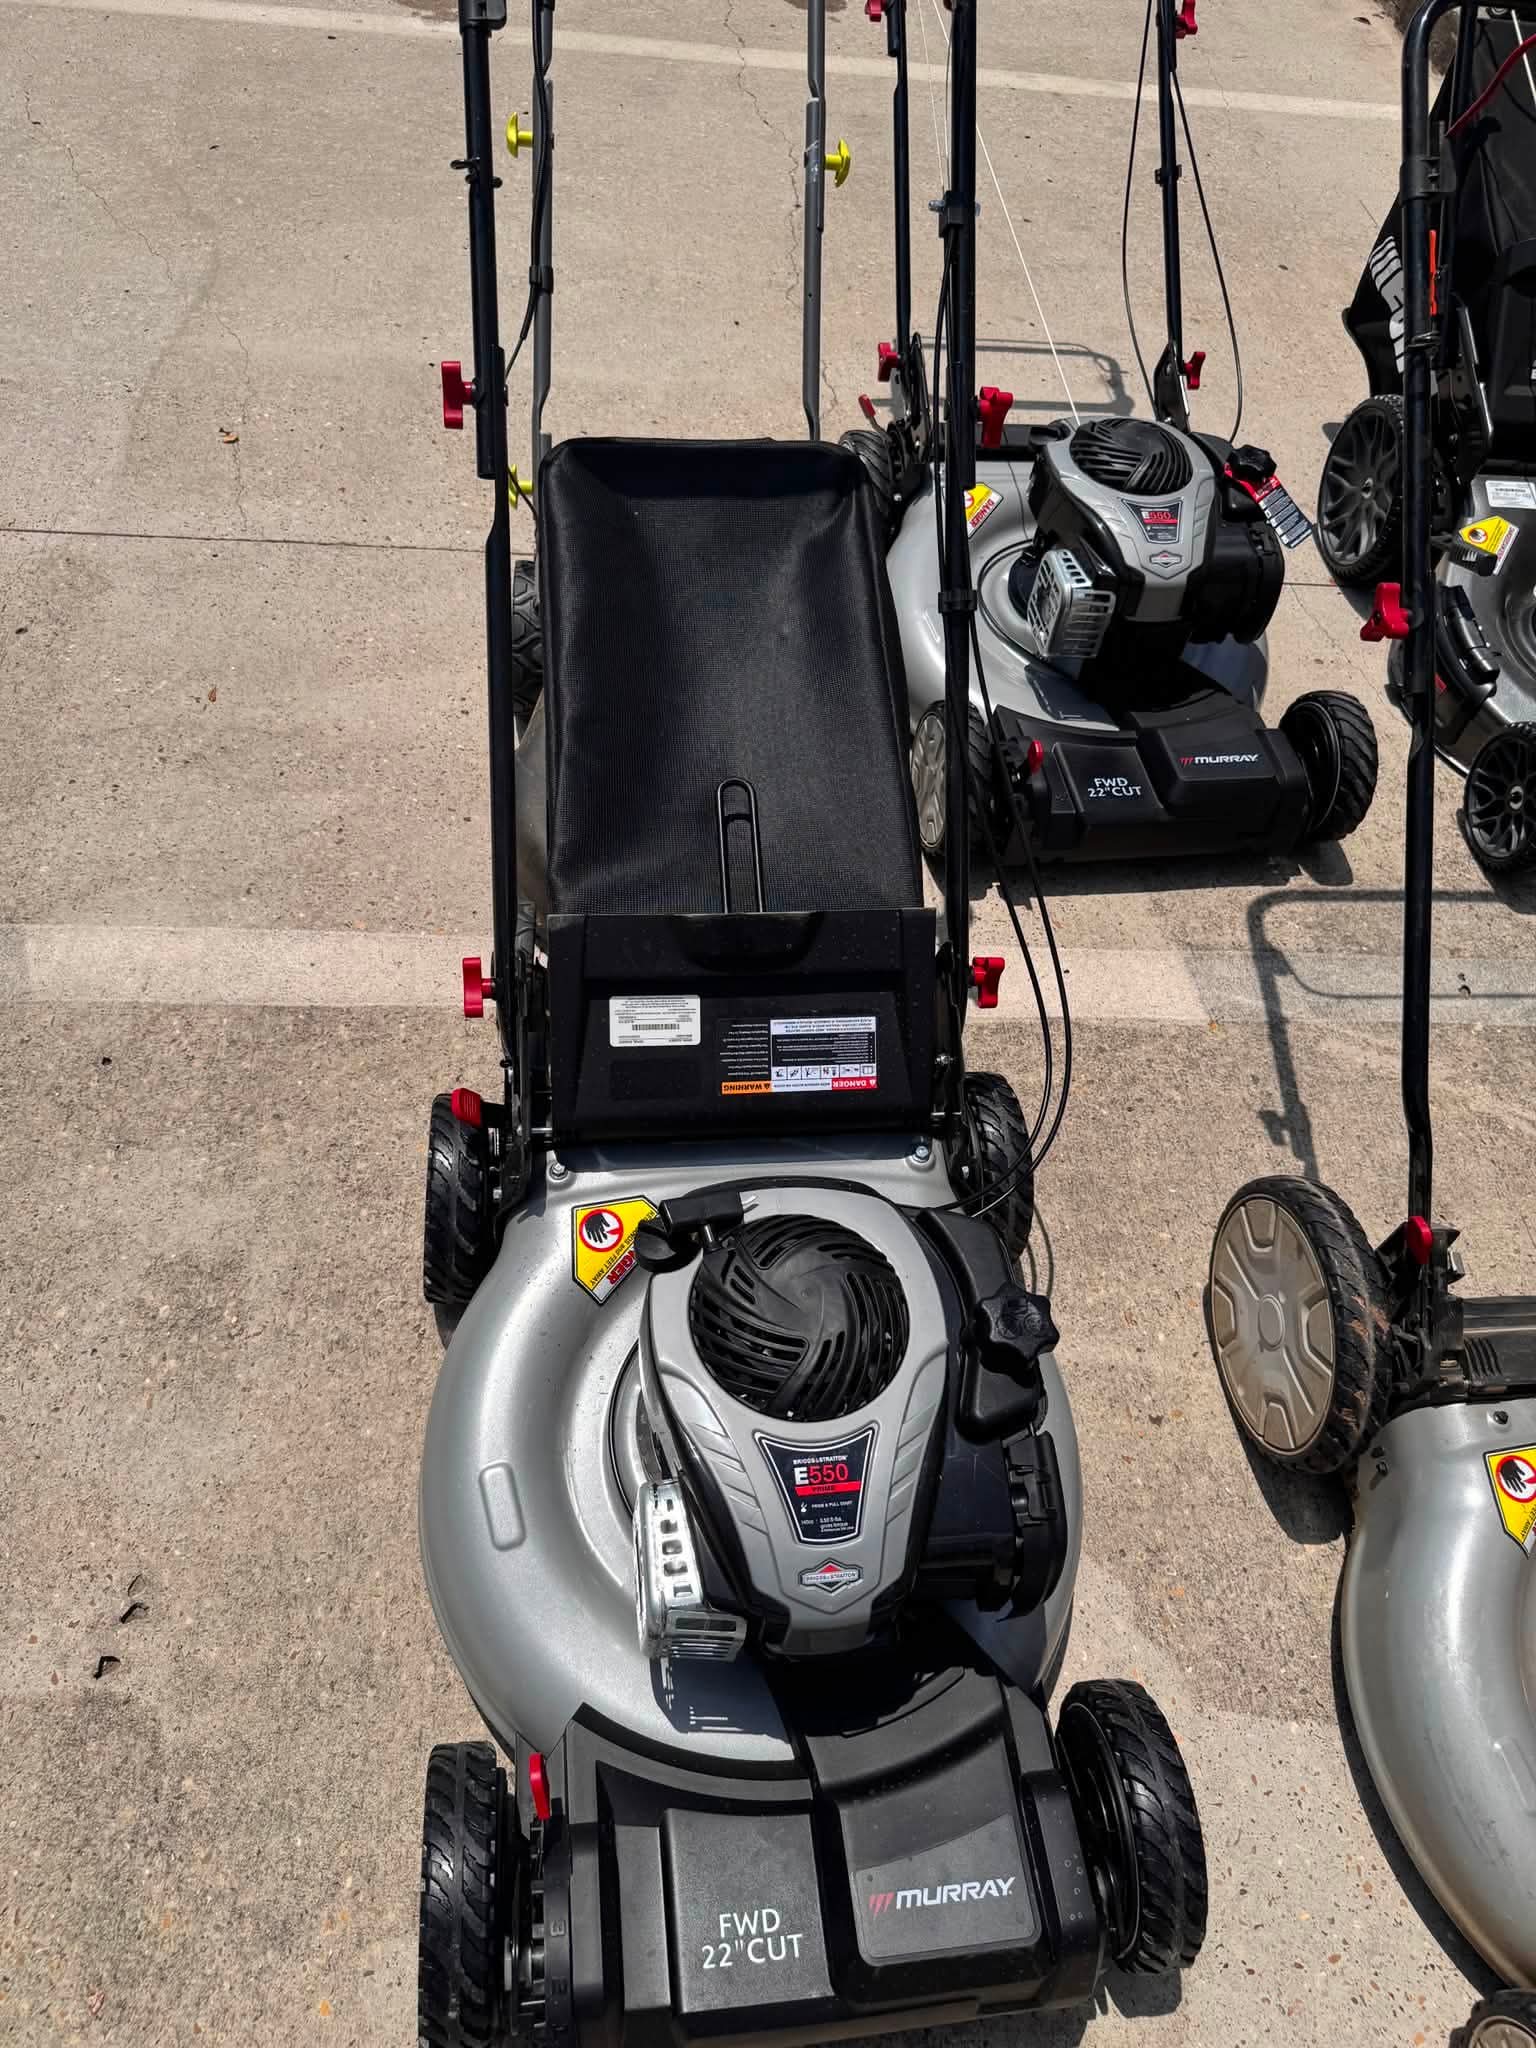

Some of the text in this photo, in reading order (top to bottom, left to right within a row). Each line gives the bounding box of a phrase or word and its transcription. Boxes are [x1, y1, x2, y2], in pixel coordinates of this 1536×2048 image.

[1194, 754, 1259, 765] MURRAY
[1094, 777, 1128, 788] FWD
[722, 1082, 763, 1093] WARNING
[832, 1078, 868, 1089] DANGER
[589, 1269, 605, 1285] AWAY
[793, 1462, 849, 1485] E550
[895, 1876, 1016, 1911] MURRAY
[718, 1908, 781, 1939] FWD
